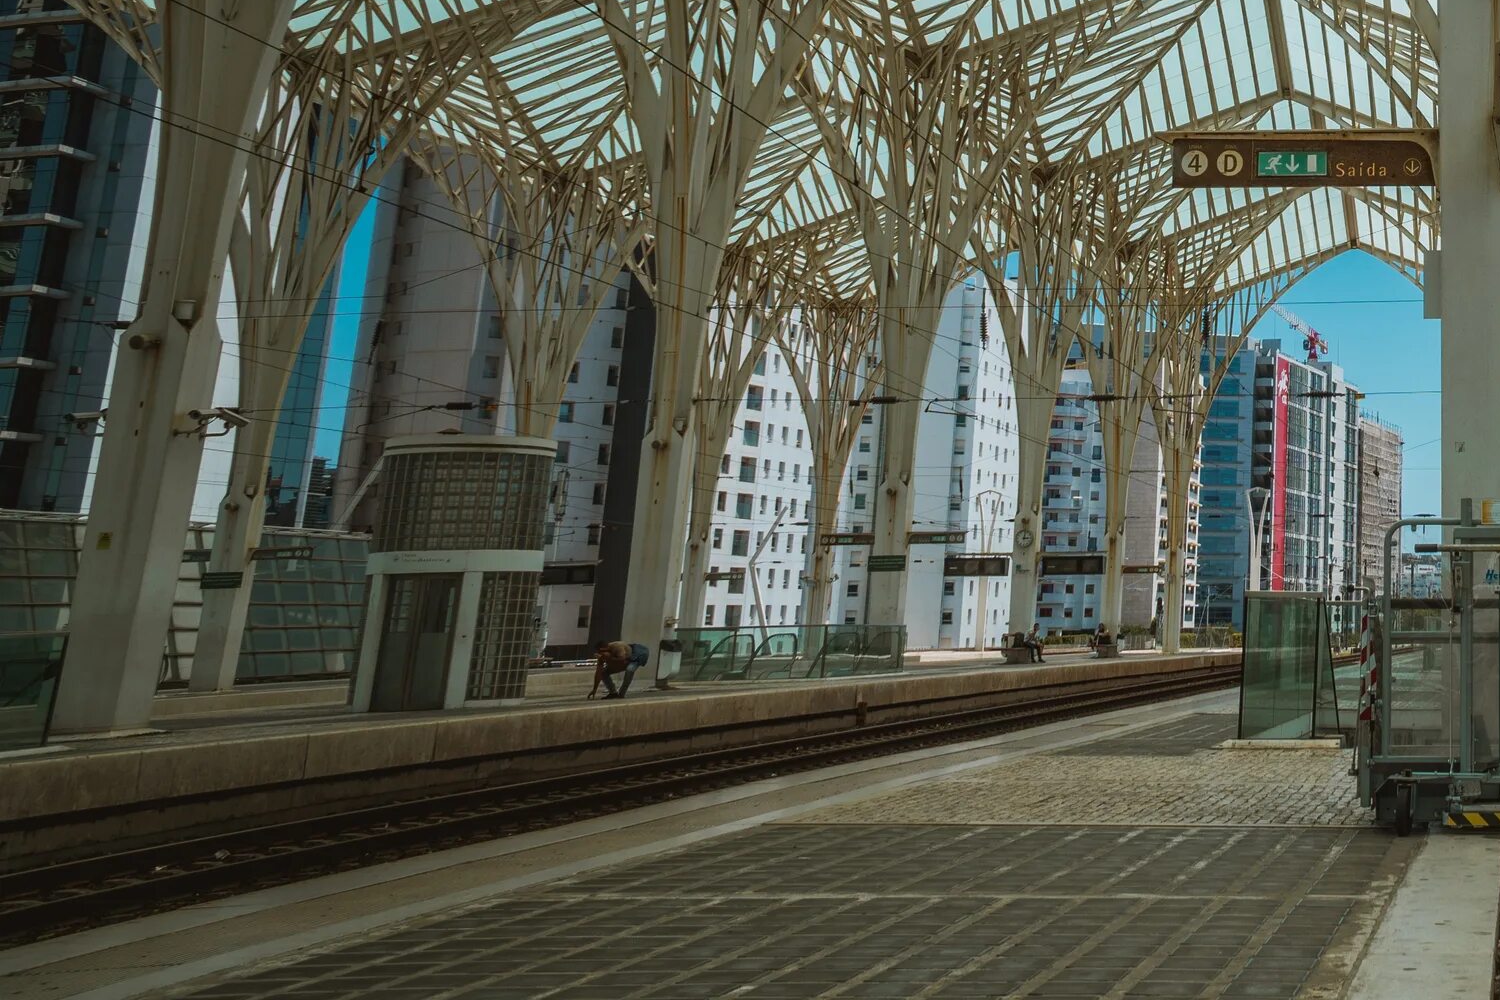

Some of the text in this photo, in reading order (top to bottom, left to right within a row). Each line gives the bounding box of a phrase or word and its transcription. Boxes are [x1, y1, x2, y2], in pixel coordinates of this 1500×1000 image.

[1188, 153, 1387, 177] 4 D Saída
